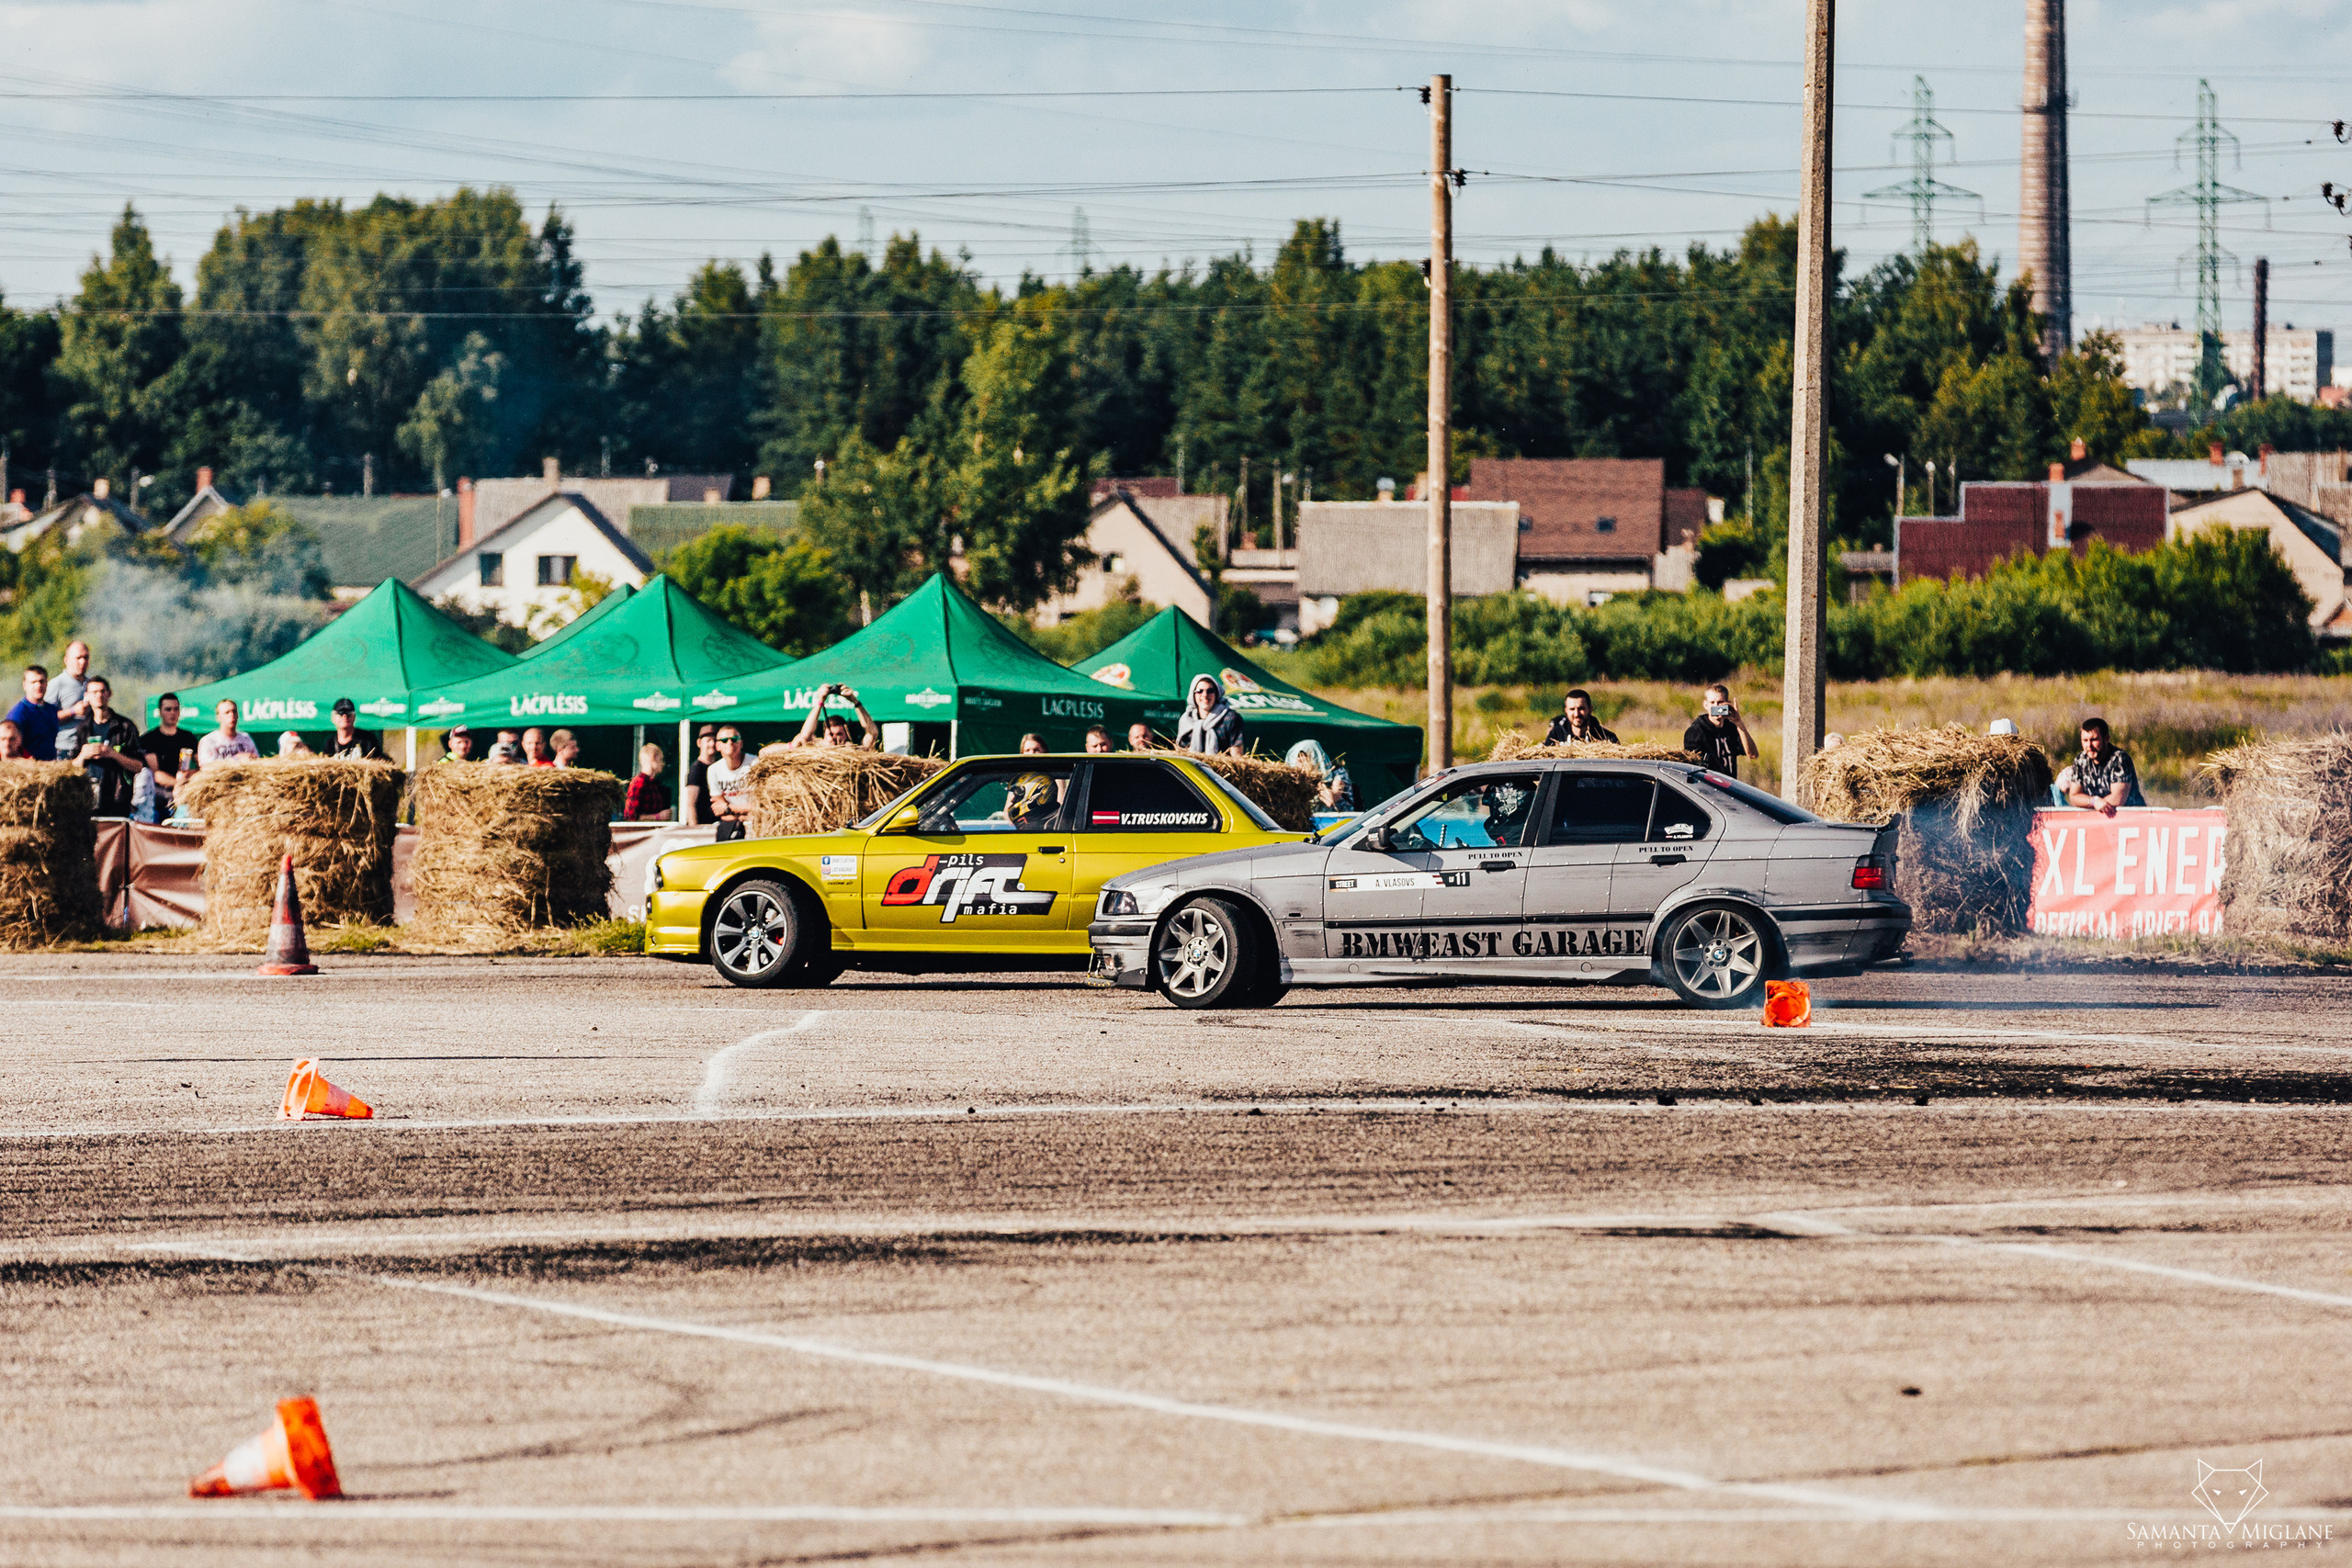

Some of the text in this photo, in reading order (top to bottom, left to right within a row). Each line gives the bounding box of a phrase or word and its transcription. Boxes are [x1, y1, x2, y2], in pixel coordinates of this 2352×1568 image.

[1121, 812, 1209, 825] V.TRUSKOVSKIS
[1501, 851, 1523, 859] OPEN
[2038, 828, 2096, 897] XL
[1335, 879, 1355, 888] STREET
[1384, 877, 1415, 887] VLASOVS
[1454, 872, 1466, 886] 11
[964, 904, 1018, 915] mafia
[1512, 930, 1645, 956] GARAGE
